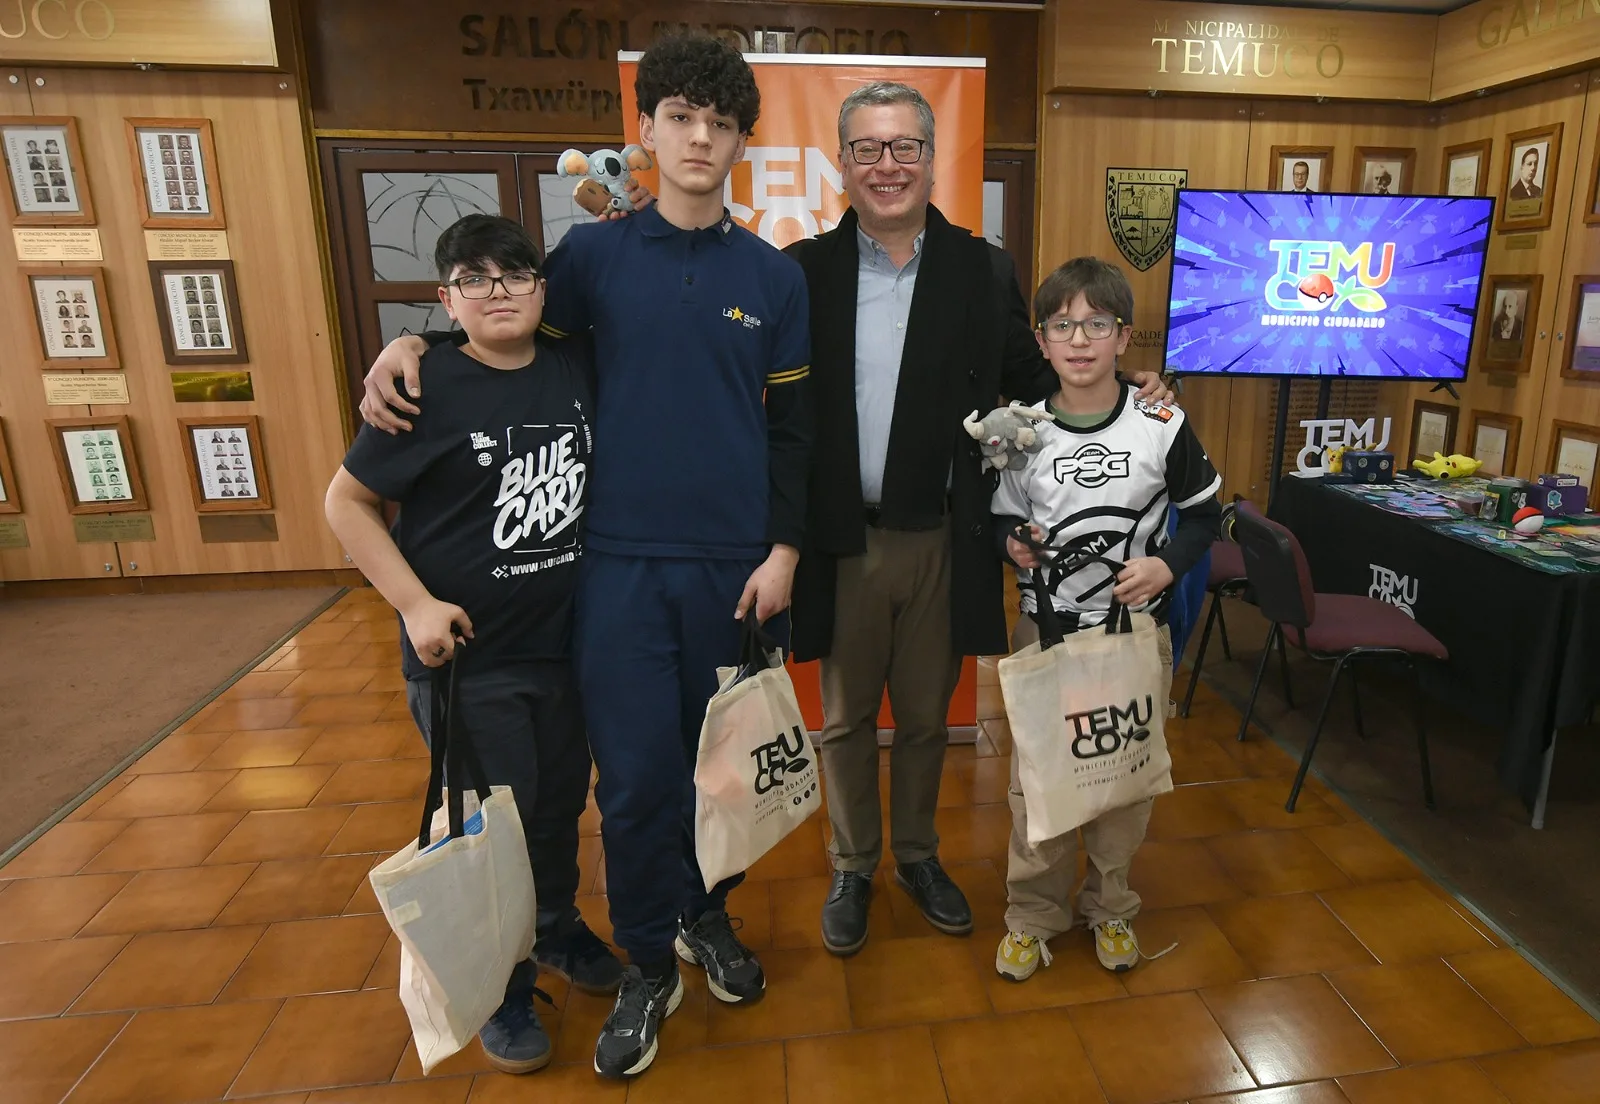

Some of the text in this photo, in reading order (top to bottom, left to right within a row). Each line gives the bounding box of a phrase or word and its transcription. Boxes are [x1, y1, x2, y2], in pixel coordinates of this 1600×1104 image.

[459, 8, 630, 60] SALÓN
[1151, 37, 1344, 79] TEMUCO
[461, 77, 622, 122] Txawüp
[1118, 172, 1177, 182] TEMUCO
[1269, 239, 1396, 289] TEMU
[1261, 314, 1386, 328] MUNICIPIO CIUDADANO
[493, 432, 576, 507] BLUE
[1053, 451, 1132, 485] PSG
[493, 463, 587, 550] CARD
[1369, 563, 1419, 605] TEMU
[1064, 693, 1153, 739] TEMU
